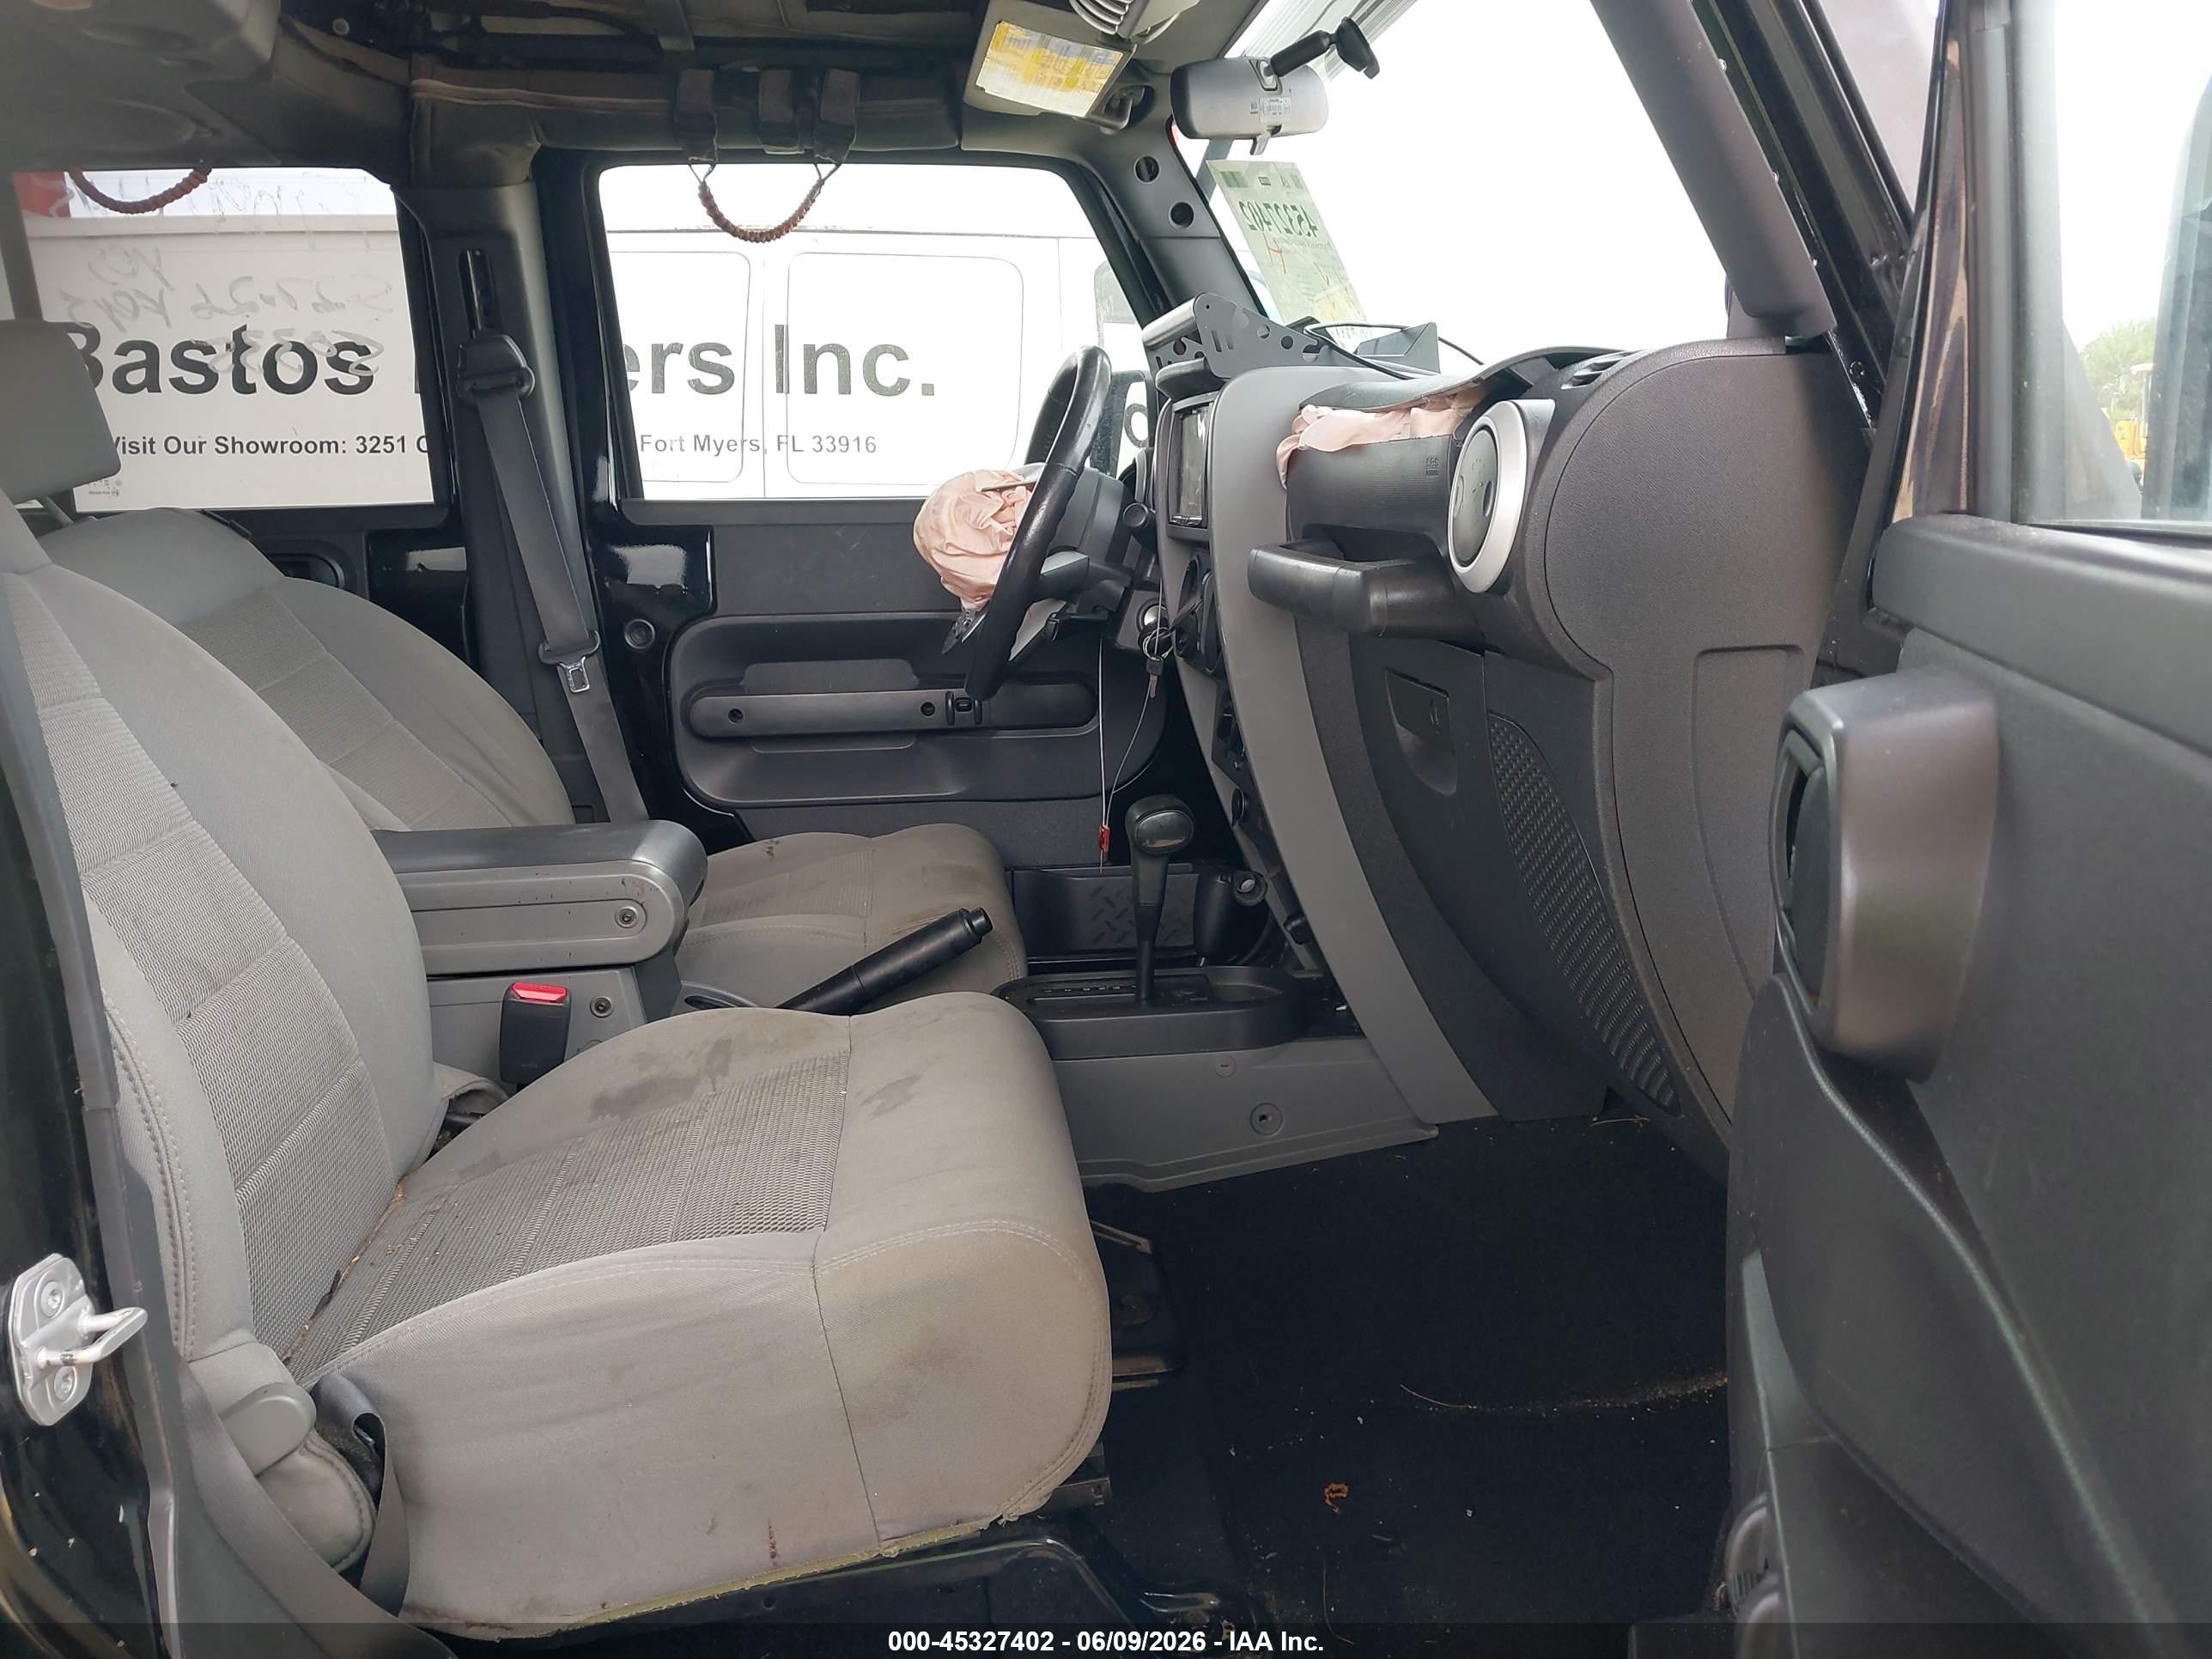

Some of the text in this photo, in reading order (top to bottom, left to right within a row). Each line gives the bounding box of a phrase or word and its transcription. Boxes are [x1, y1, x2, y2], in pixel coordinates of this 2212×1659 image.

[58, 321, 374, 395] Bastos
[775, 325, 935, 396] Inc.
[164, 435, 207, 455] Our
[215, 435, 347, 455] Showroom:
[356, 435, 405, 454] 3251
[640, 434, 685, 453] Fort
[694, 434, 768, 456] Myers,
[777, 434, 805, 453] FL
[811, 435, 877, 453] 33916
